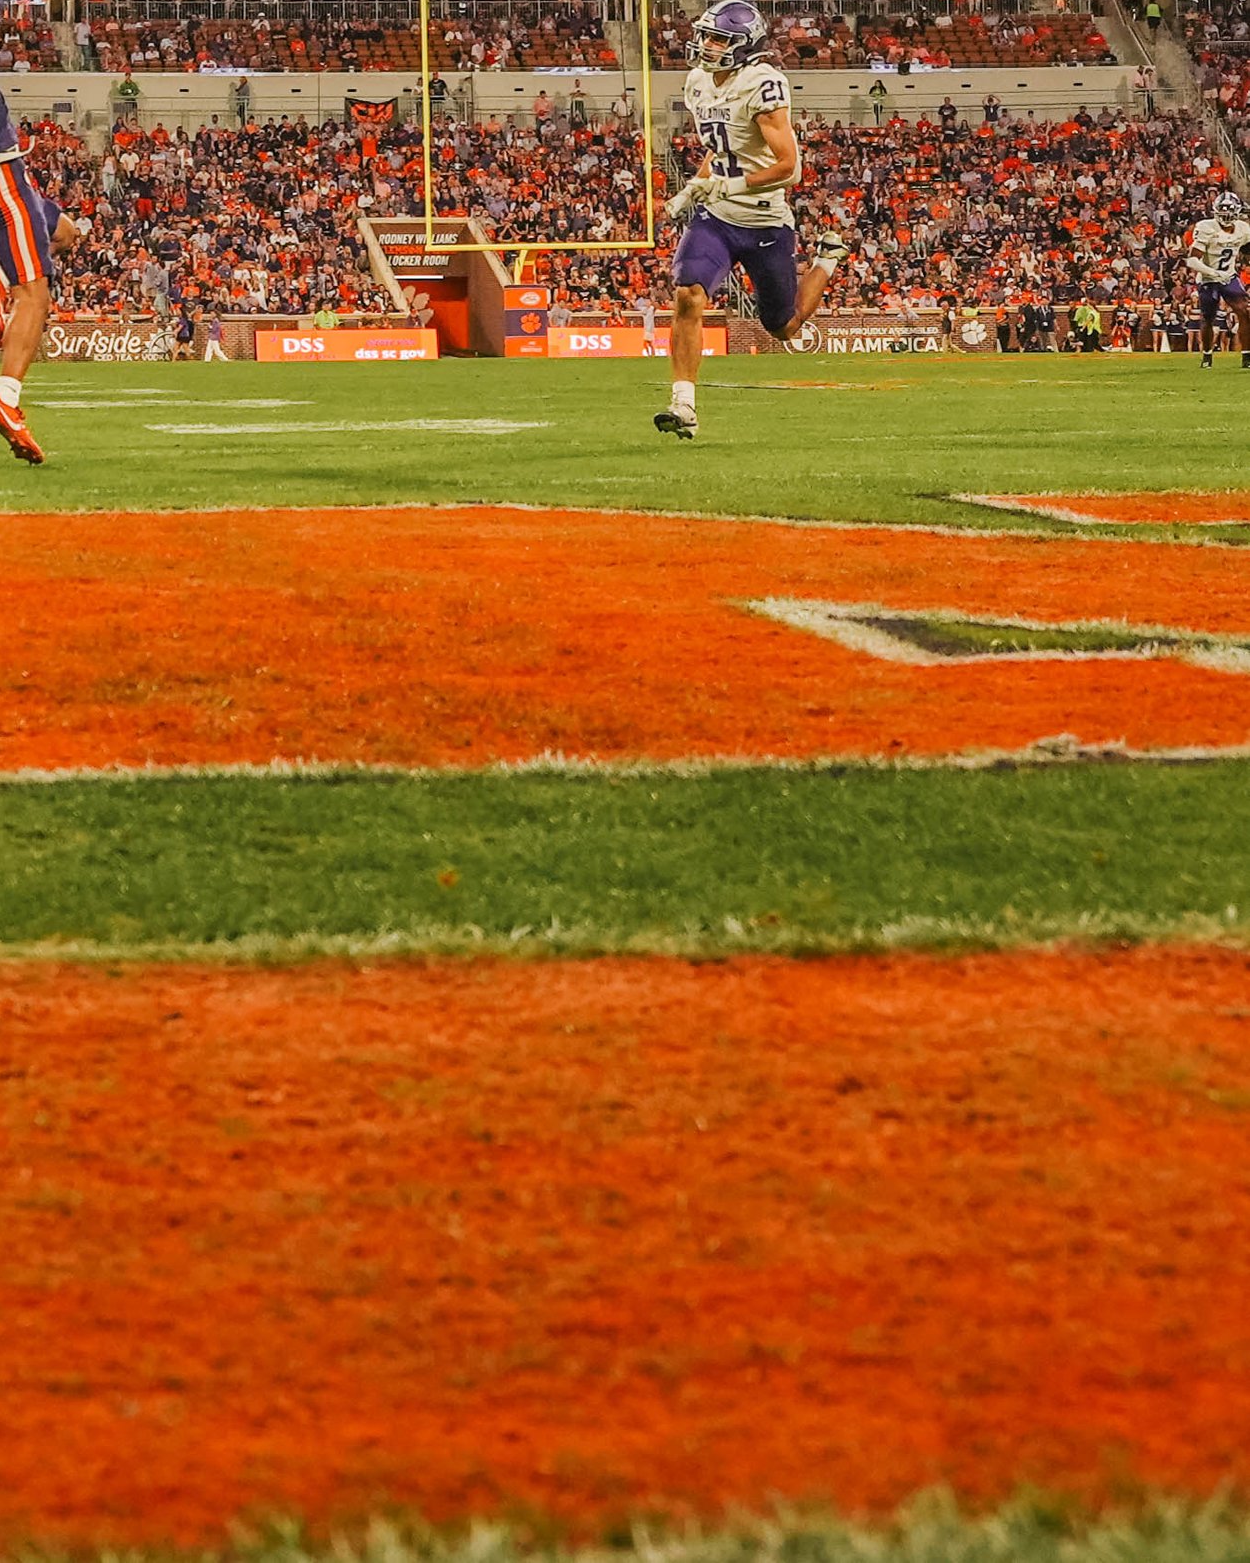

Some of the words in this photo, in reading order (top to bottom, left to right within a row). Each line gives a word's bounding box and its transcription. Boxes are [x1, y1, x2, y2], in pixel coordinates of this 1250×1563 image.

[760, 79, 786, 103] 21
[695, 106, 731, 122] PALADINS
[378, 234, 414, 244] RODNEY
[415, 233, 458, 244] WILIAMS
[388, 255, 421, 266] LOCKER
[422, 255, 450, 266] ROOM
[1217, 248, 1233, 272] 2
[850, 327, 887, 335] PROUDLY
[47, 326, 142, 358] Surfside
[283, 338, 325, 353] DSS
[569, 334, 612, 350] DSS
[827, 338, 847, 353] IN
[93, 353, 113, 362] ICED
[116, 353, 132, 362] TEA
